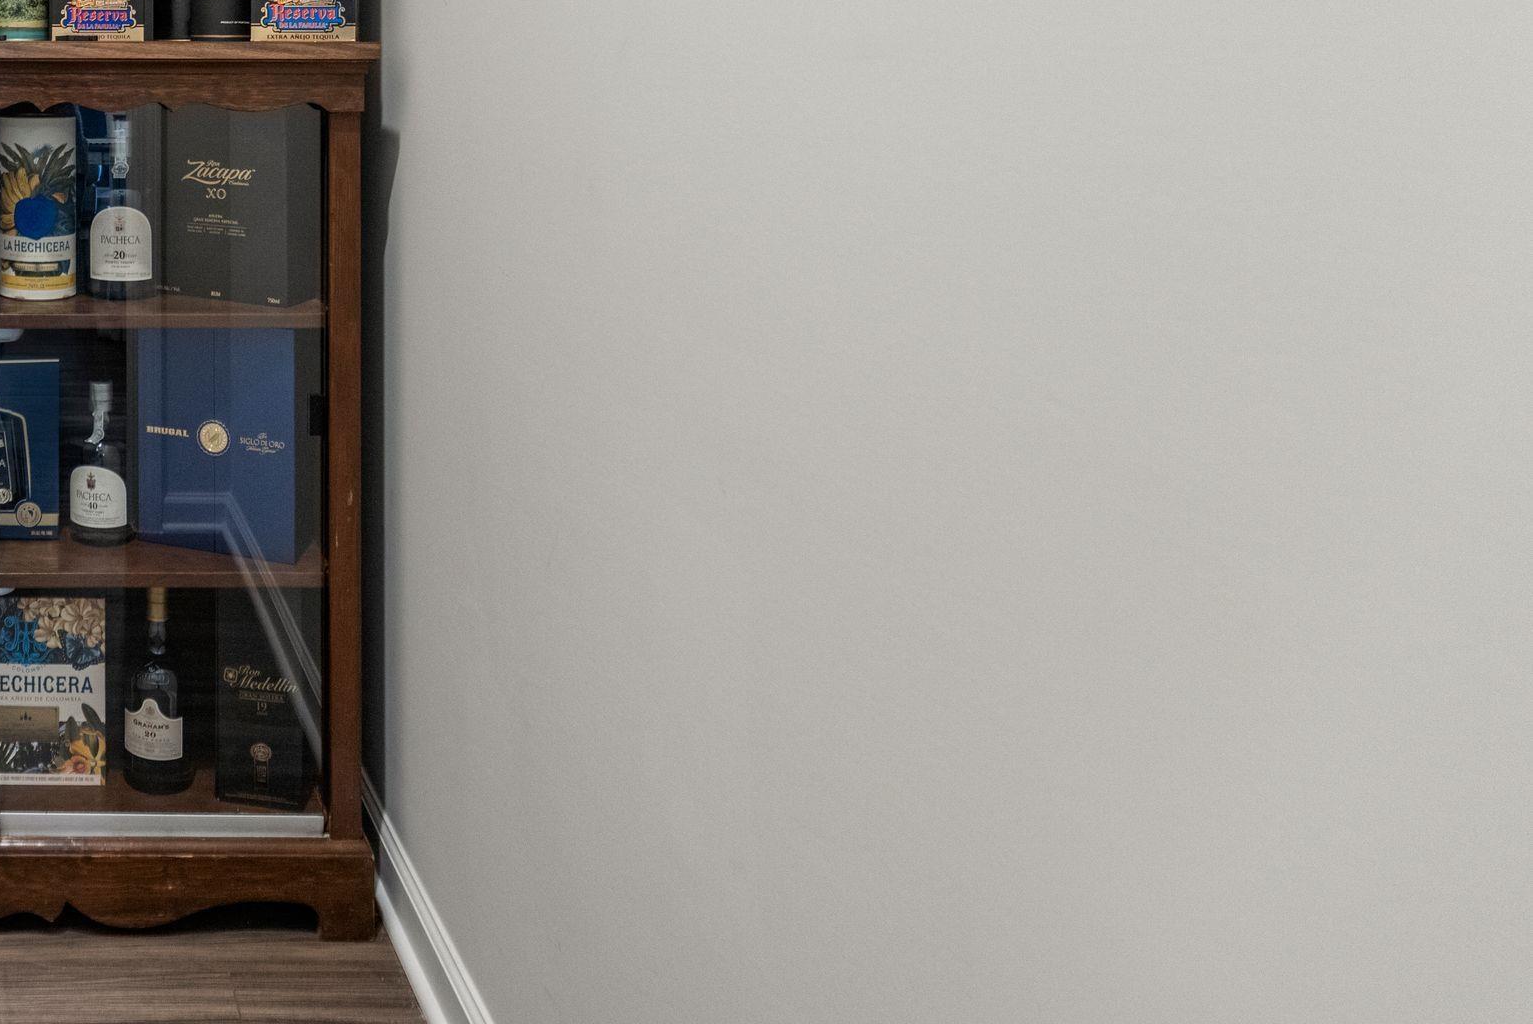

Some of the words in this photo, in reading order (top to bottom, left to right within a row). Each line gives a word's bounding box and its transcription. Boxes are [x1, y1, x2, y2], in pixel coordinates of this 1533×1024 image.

[68, 7, 128, 23] Reserva
[269, 4, 336, 22] Reserva
[181, 160, 255, 185] Zacapa
[206, 188, 226, 199] XO
[100, 235, 140, 245] PACHECA
[3, 240, 12, 250] LA
[14, 240, 70, 253] HECHICERA
[113, 251, 125, 259] 20
[146, 425, 189, 438] BRUGAL
[76, 489, 112, 501] PACHECA
[144, 730, 156, 738] 20
